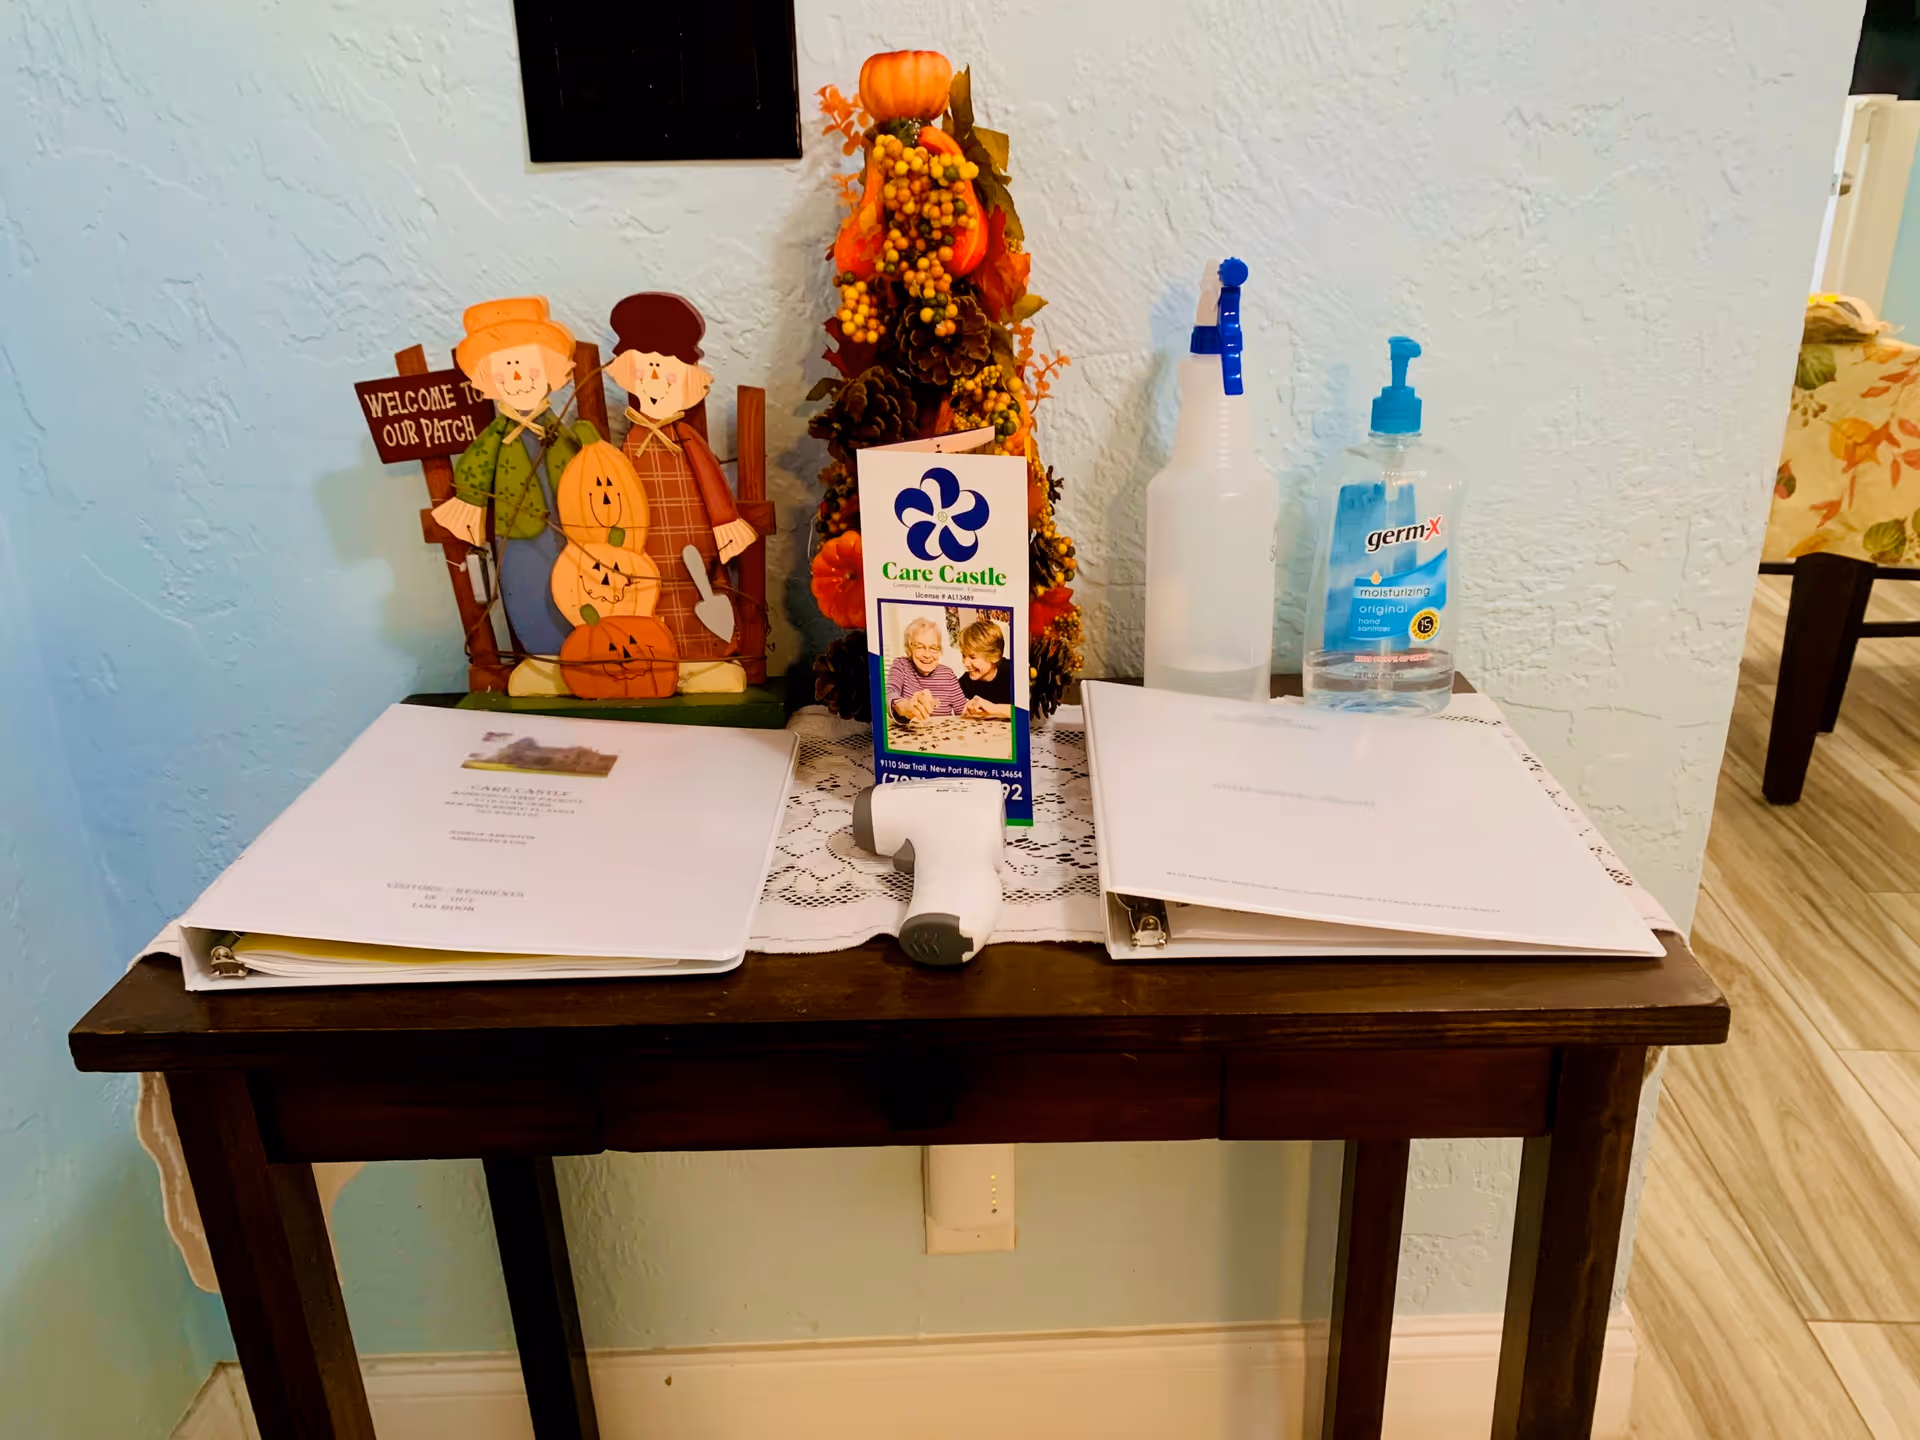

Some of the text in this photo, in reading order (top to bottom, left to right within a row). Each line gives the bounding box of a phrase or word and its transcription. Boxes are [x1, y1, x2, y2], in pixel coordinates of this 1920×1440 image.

[364, 384, 457, 418] WELCOME
[383, 415, 477, 448] OUR PATCH
[882, 561, 1007, 586] Care Castle
[915, 591, 940, 600] License
[1360, 587, 1430, 598] moisturizing
[1359, 604, 1408, 616] original
[1420, 618, 1431, 631] 15
[880, 759, 897, 769] 9110
[897, 761, 912, 770] Star
[930, 765, 947, 774] New
[948, 766, 963, 775] Port
[991, 770, 1000, 778] FL
[1000, 770, 1023, 779] 34654
